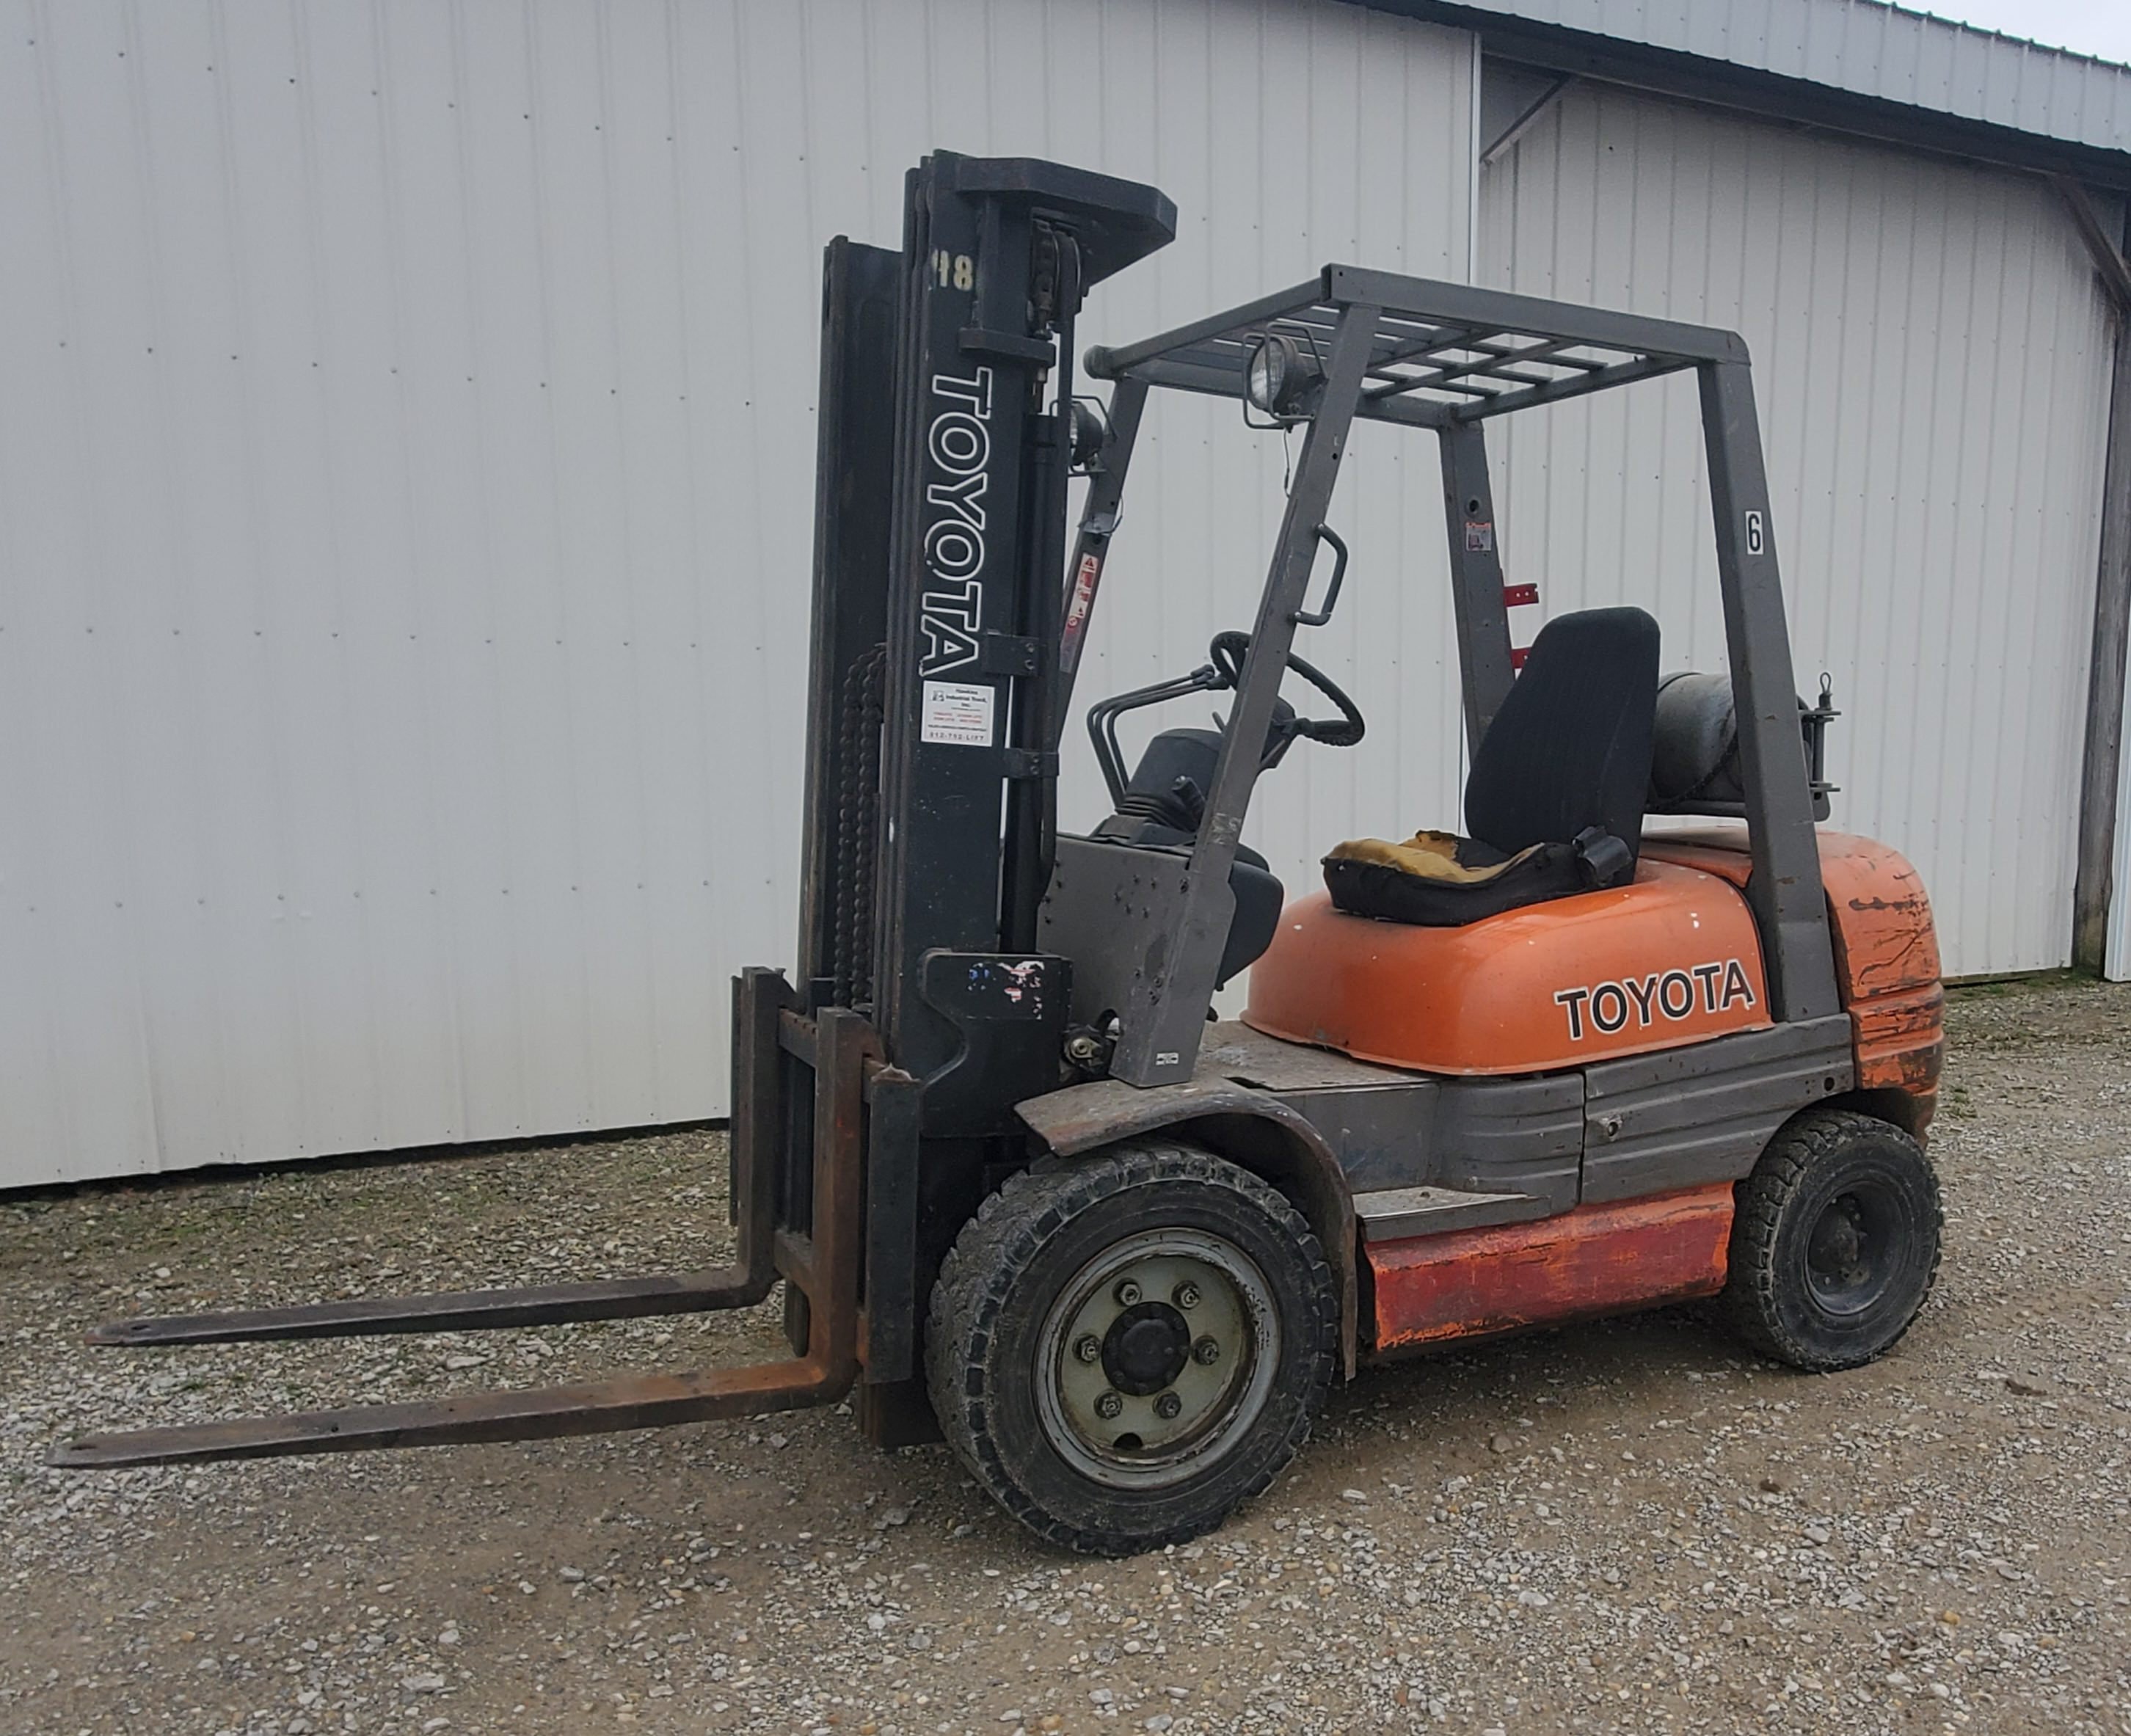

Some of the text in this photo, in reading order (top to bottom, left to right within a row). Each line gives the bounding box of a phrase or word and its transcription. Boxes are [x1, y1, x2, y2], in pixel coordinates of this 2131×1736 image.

[919, 367, 993, 676] TOYOTA
[1748, 513, 1761, 552] 6
[1553, 958, 1756, 1041] TOYOTA
